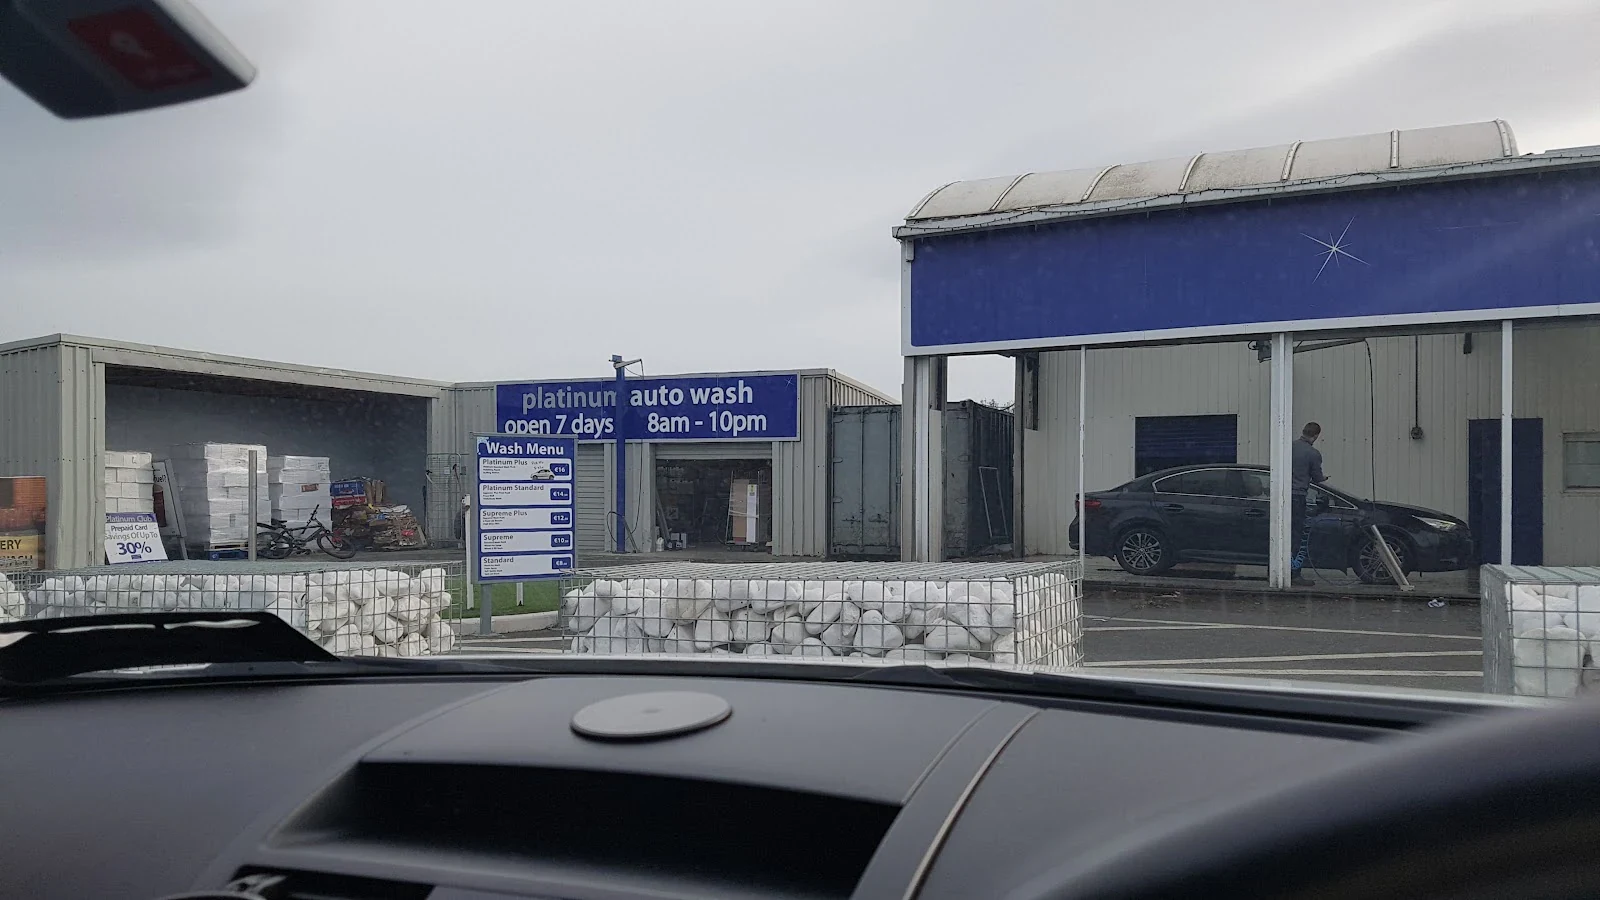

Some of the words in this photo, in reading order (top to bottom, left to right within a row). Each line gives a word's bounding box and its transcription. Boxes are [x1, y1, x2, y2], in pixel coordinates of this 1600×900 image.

[630, 385, 684, 406] auto
[690, 380, 753, 405] wash
[504, 418, 551, 434] open
[555, 414, 567, 434] 7
[571, 412, 614, 439] days
[647, 412, 690, 433] 8am
[709, 410, 767, 437] 10pm
[486, 442, 523, 455] Wash
[526, 443, 564, 455] Menu
[482, 458, 513, 466] Platinum
[106, 515, 135, 523] Platinum
[140, 532, 150, 540] Up
[116, 541, 152, 555] 30%
